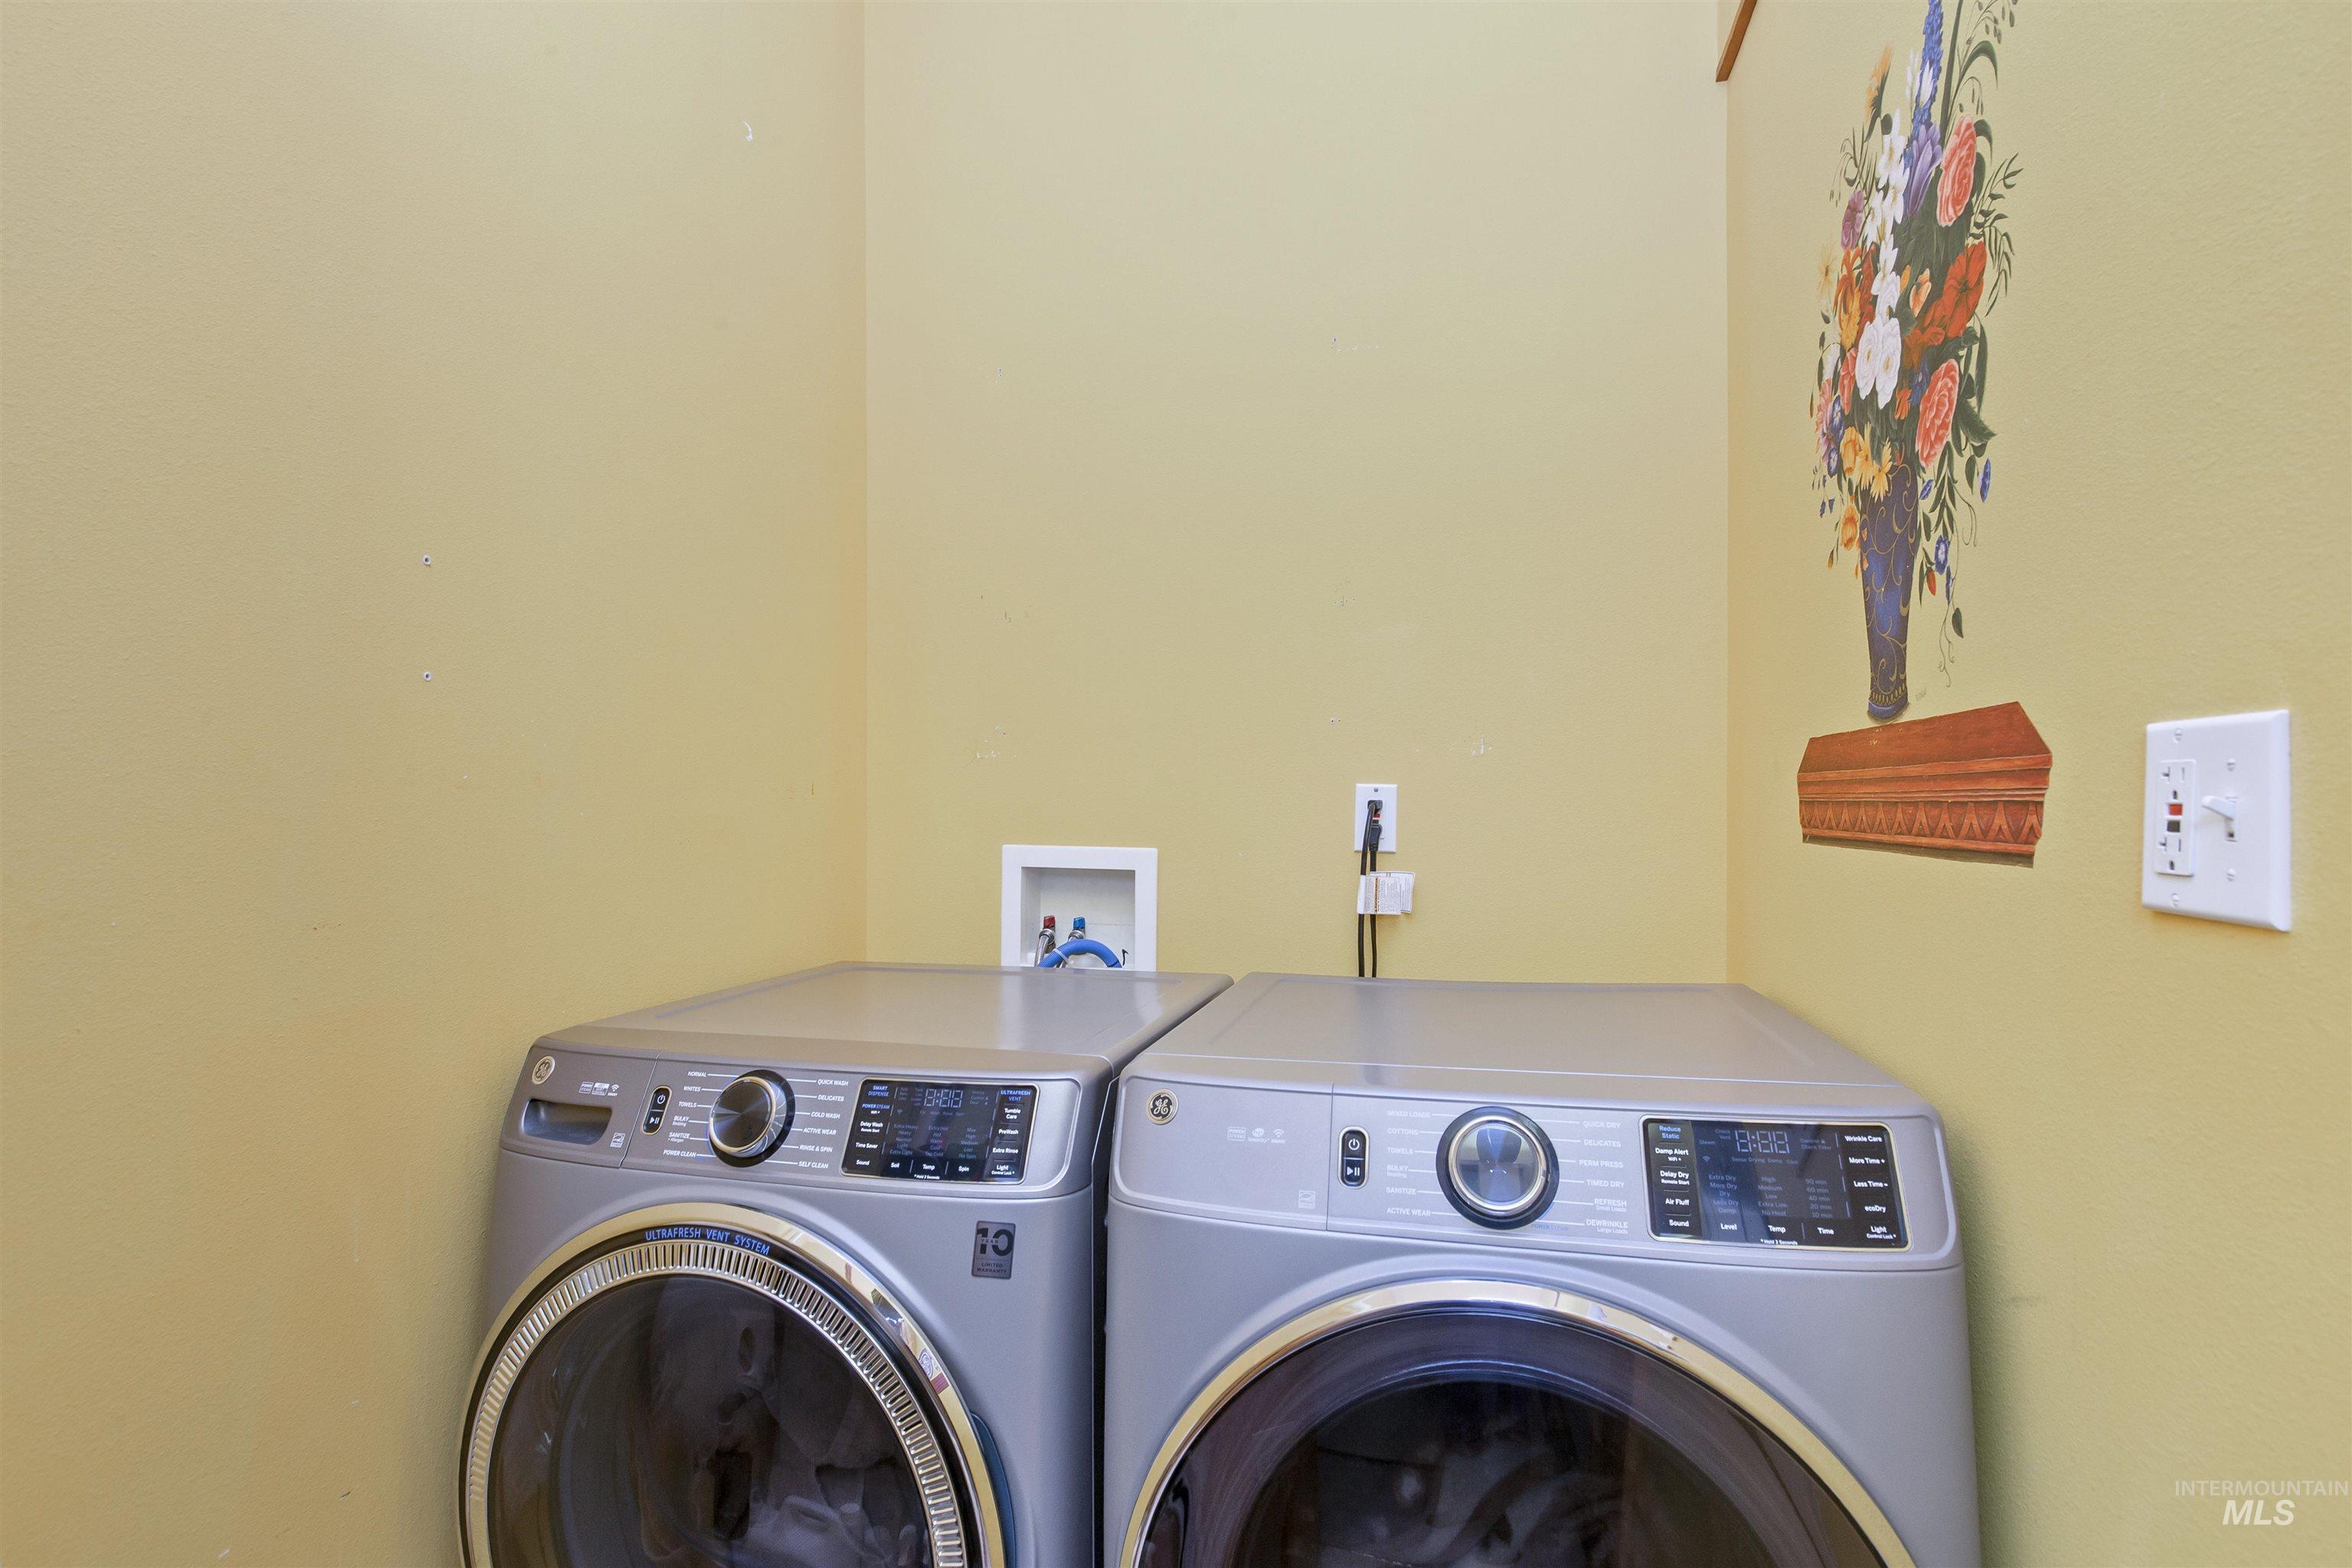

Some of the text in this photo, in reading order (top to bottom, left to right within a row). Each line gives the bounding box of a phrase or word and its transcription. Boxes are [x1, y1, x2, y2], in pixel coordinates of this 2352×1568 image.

[1584, 1139, 1622, 1148] DELICATES
[1594, 1198, 1627, 1207] REFRESH
[1586, 1219, 1628, 1229] DEWRINKLE
[1768, 1225, 1786, 1233] Temp
[645, 1227, 770, 1256] ULTRAFRESH VENT SYSTEM
[977, 1228, 1014, 1256] 10
